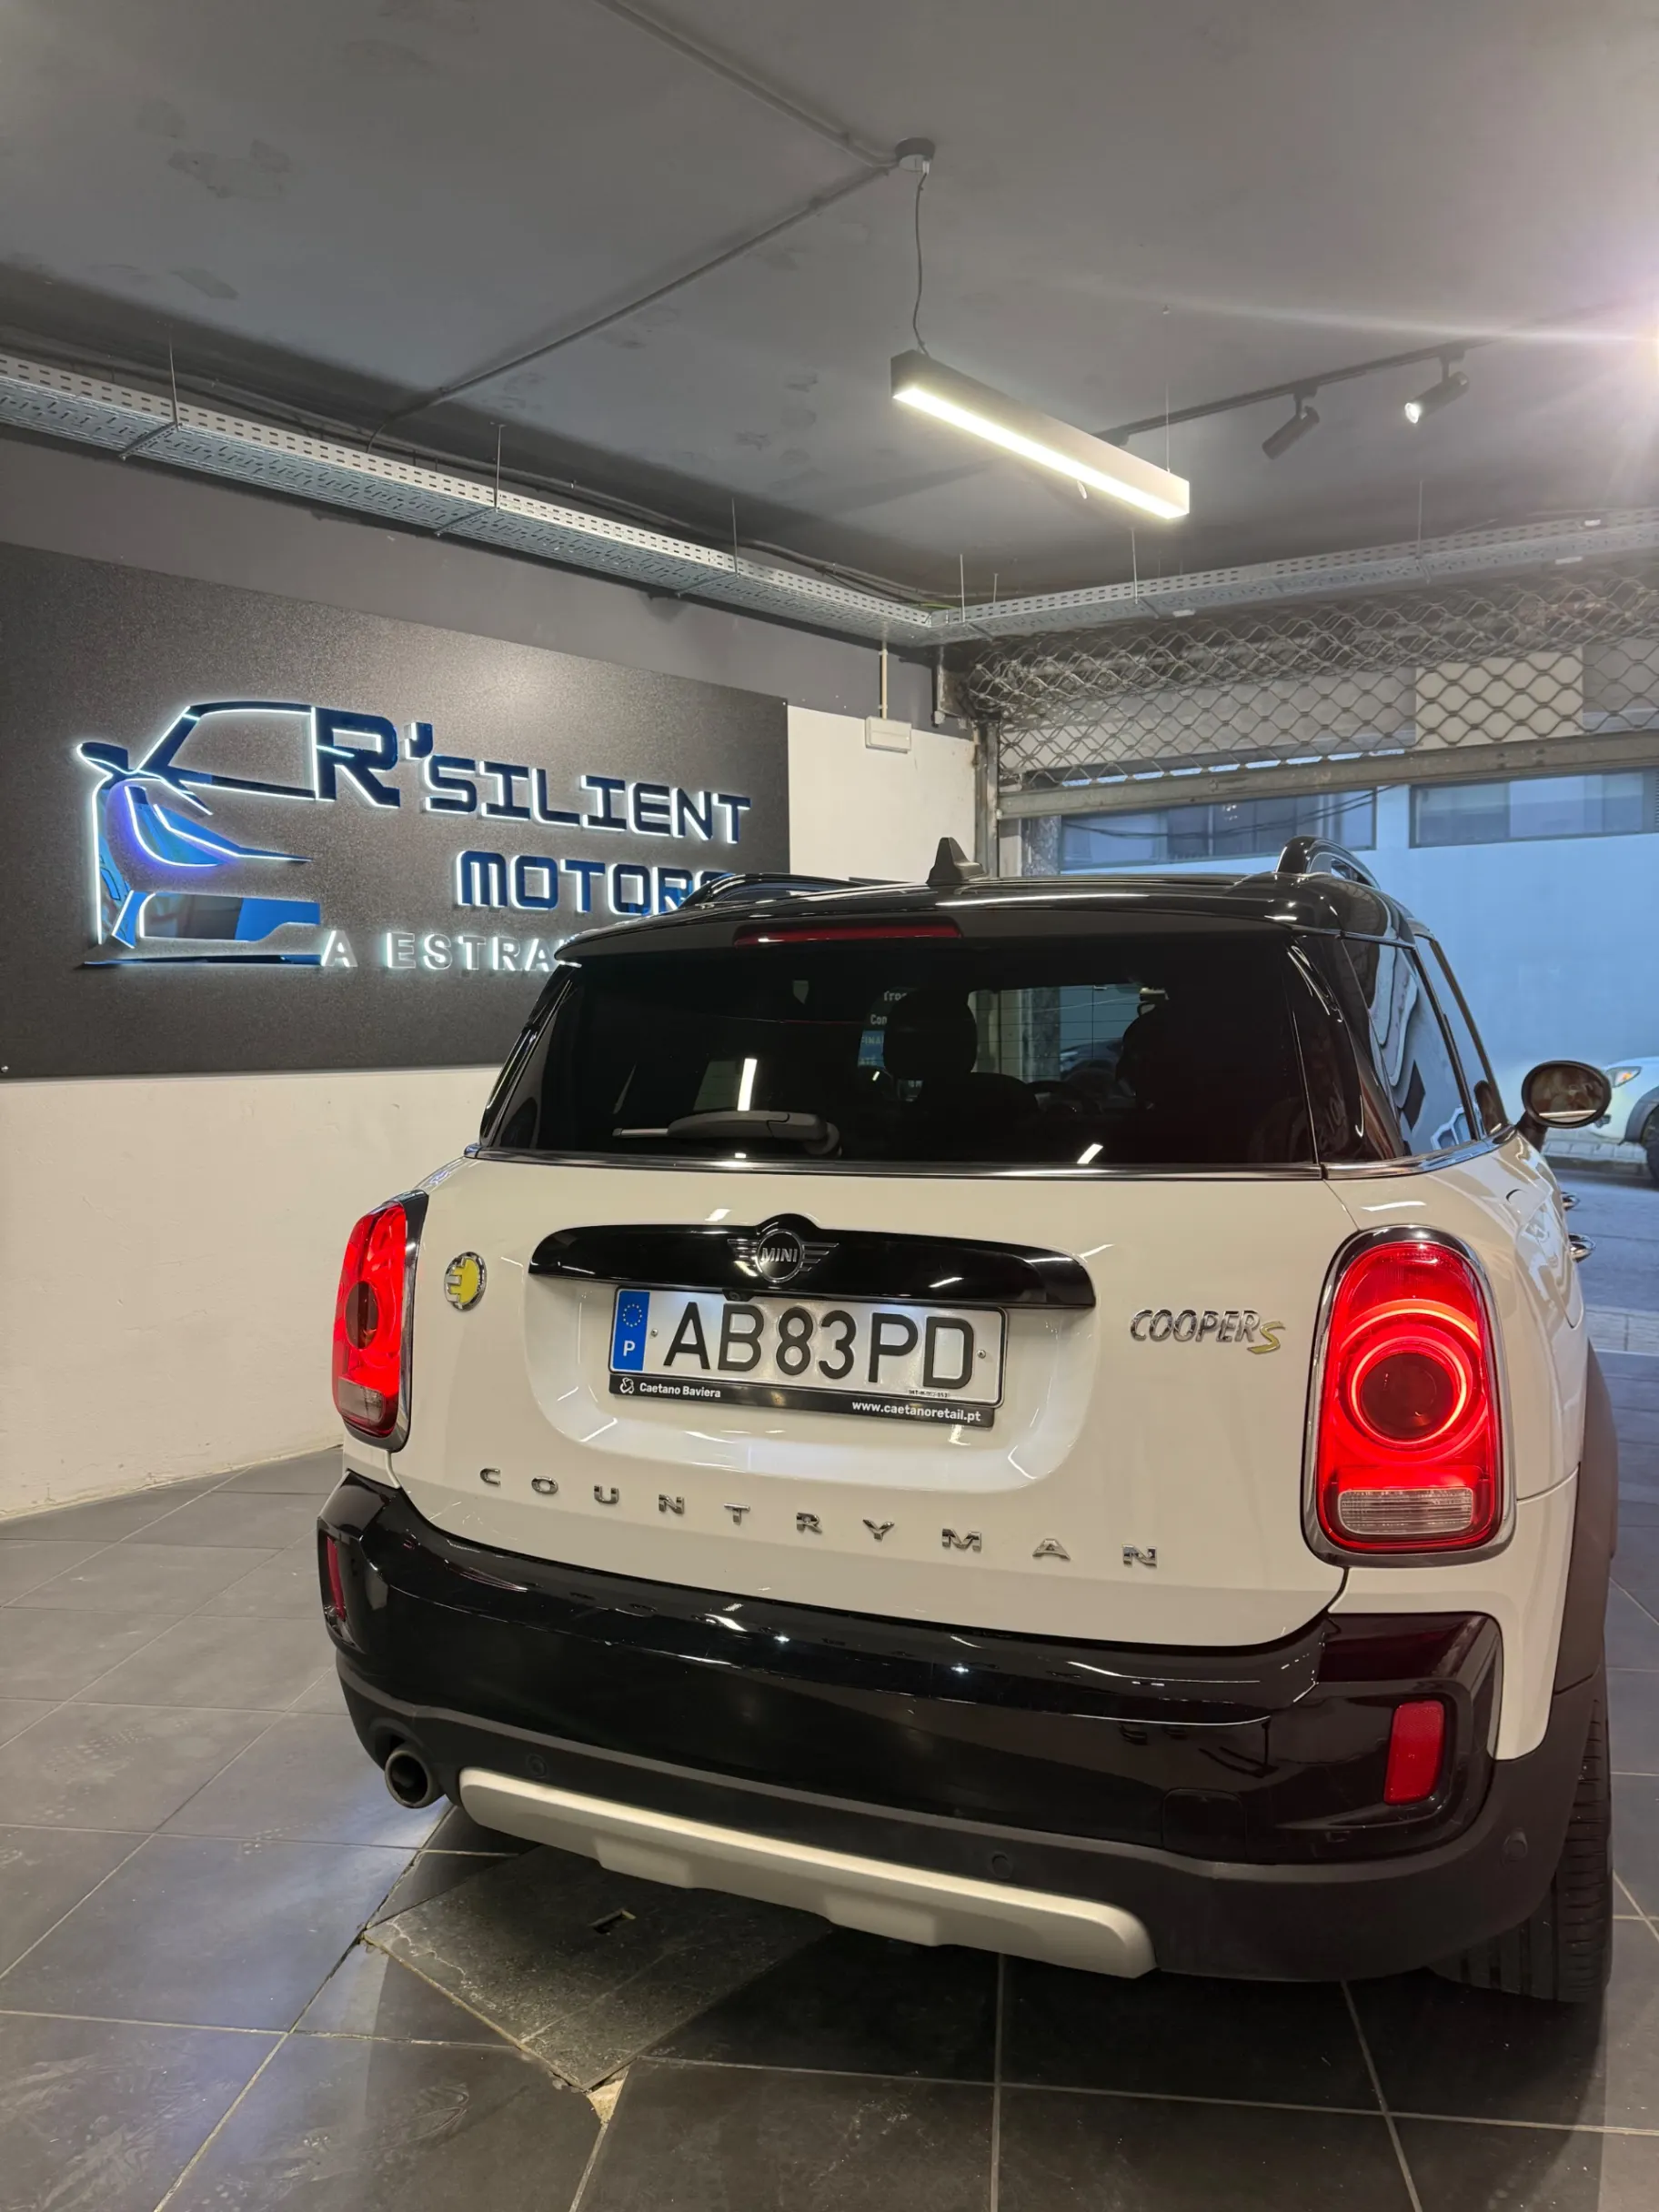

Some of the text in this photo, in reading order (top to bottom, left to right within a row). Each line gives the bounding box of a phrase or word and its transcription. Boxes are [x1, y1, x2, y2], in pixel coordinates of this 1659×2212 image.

[311, 706, 751, 844] R'SILIENT
[320, 930, 565, 971] A ESTRA
[760, 1247, 799, 1262] MINI
[622, 1339, 636, 1356] P
[639, 1382, 721, 1399] Caetano Baviera
[851, 1400, 982, 1423] www.caetanoretail.pt
[478, 1466, 1159, 1569] COUNTRYMAN
